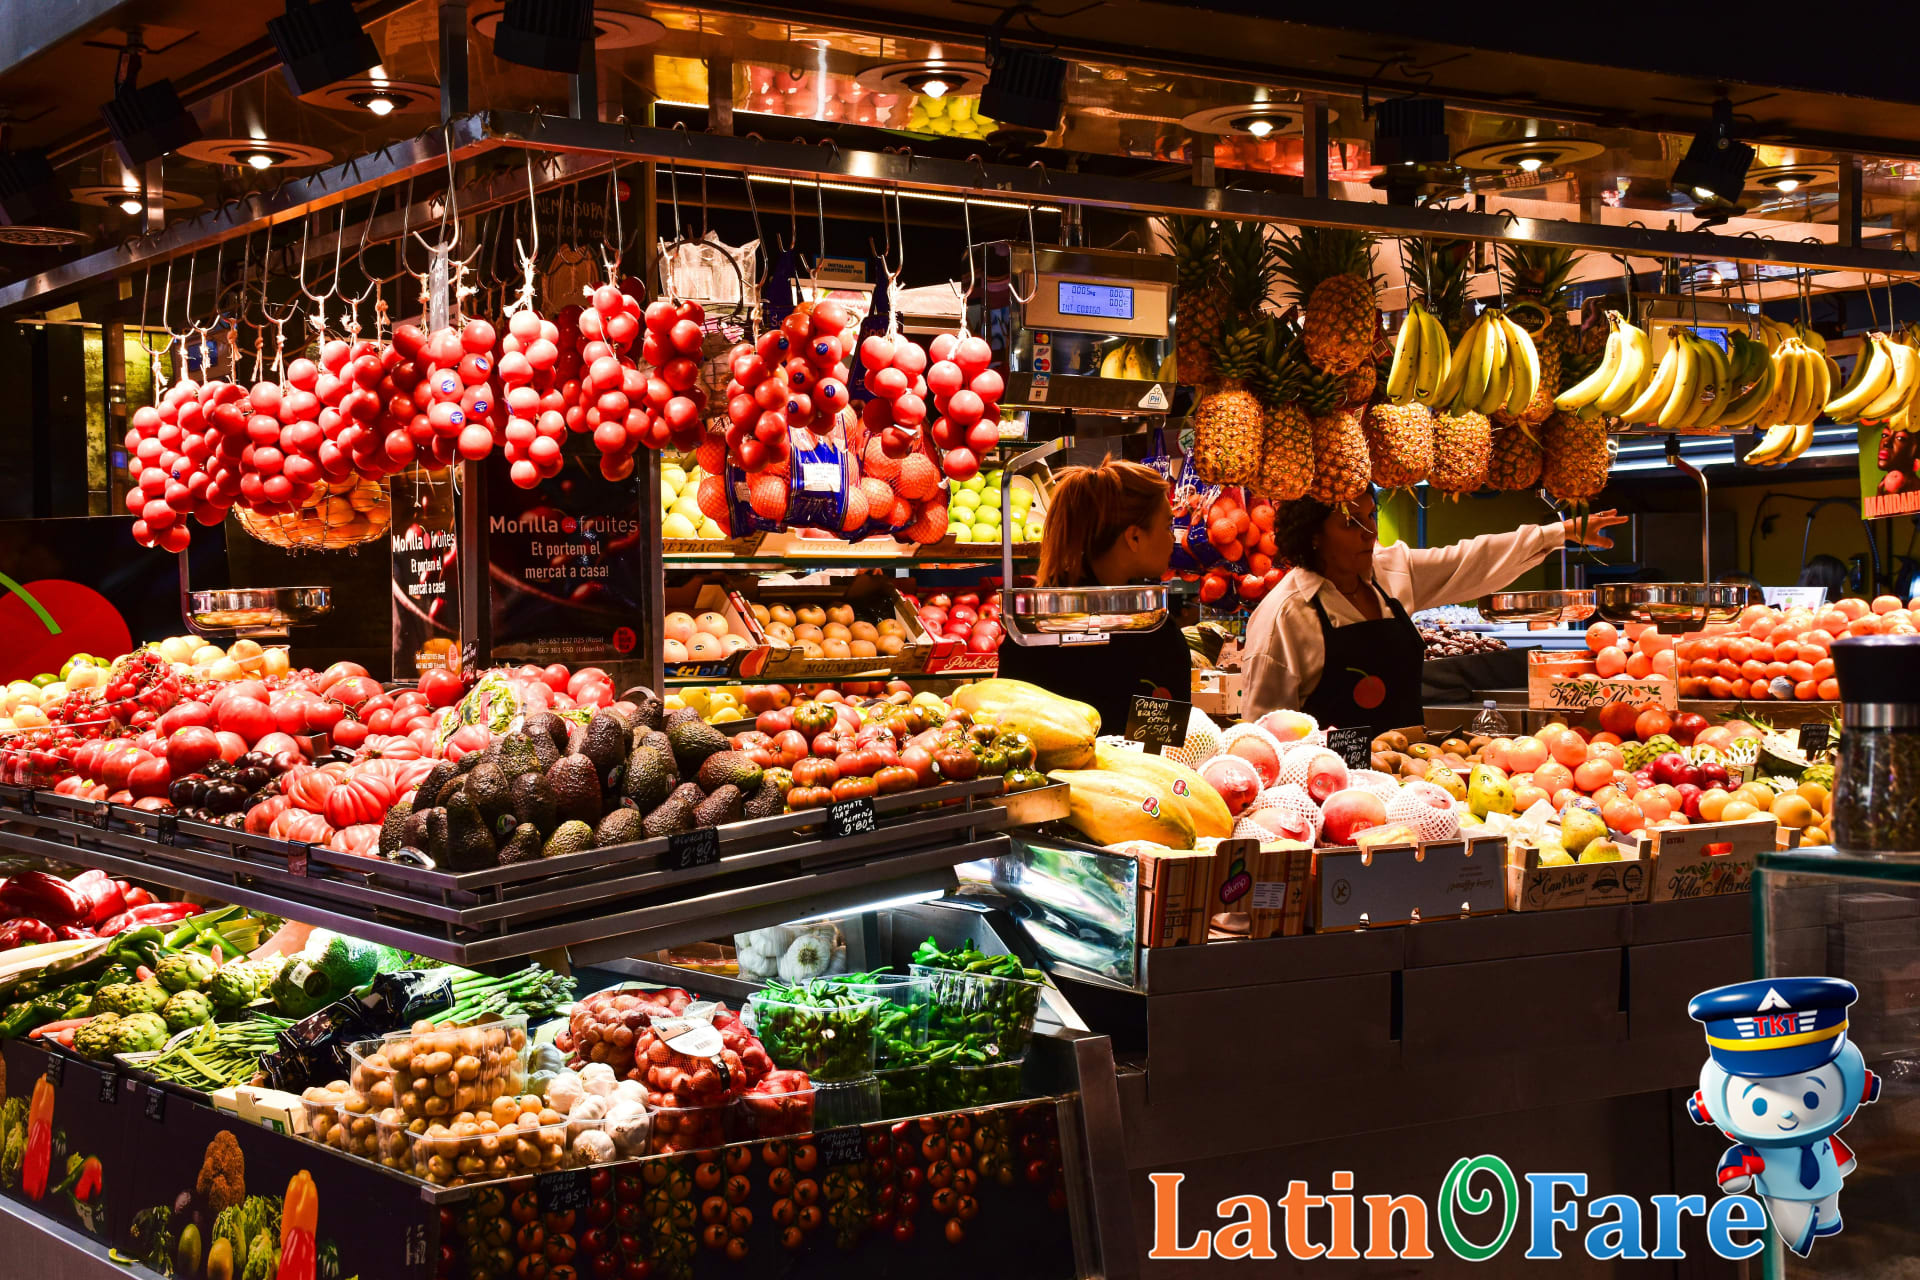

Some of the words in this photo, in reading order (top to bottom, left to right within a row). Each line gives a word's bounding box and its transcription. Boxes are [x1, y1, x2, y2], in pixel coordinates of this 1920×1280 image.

[1864, 488, 1920, 517] MANDARI
[489, 515, 558, 534] Morilla
[579, 515, 638, 534] fruites
[392, 534, 424, 553] Morilla
[431, 529, 455, 549] fruites
[531, 541, 543, 556] Et
[546, 542, 587, 559] portem
[590, 541, 601, 555] el
[418, 558, 436, 576] portem
[525, 565, 567, 579] mercat
[570, 567, 577, 578] a
[580, 565, 609, 578] casa!
[408, 580, 428, 595] mercat
[944, 655, 982, 670] Pink
[979, 656, 999, 669] La
[1549, 687, 1590, 707] Villa
[1223, 878, 1247, 898] plump
[1668, 875, 1702, 900] Villa
